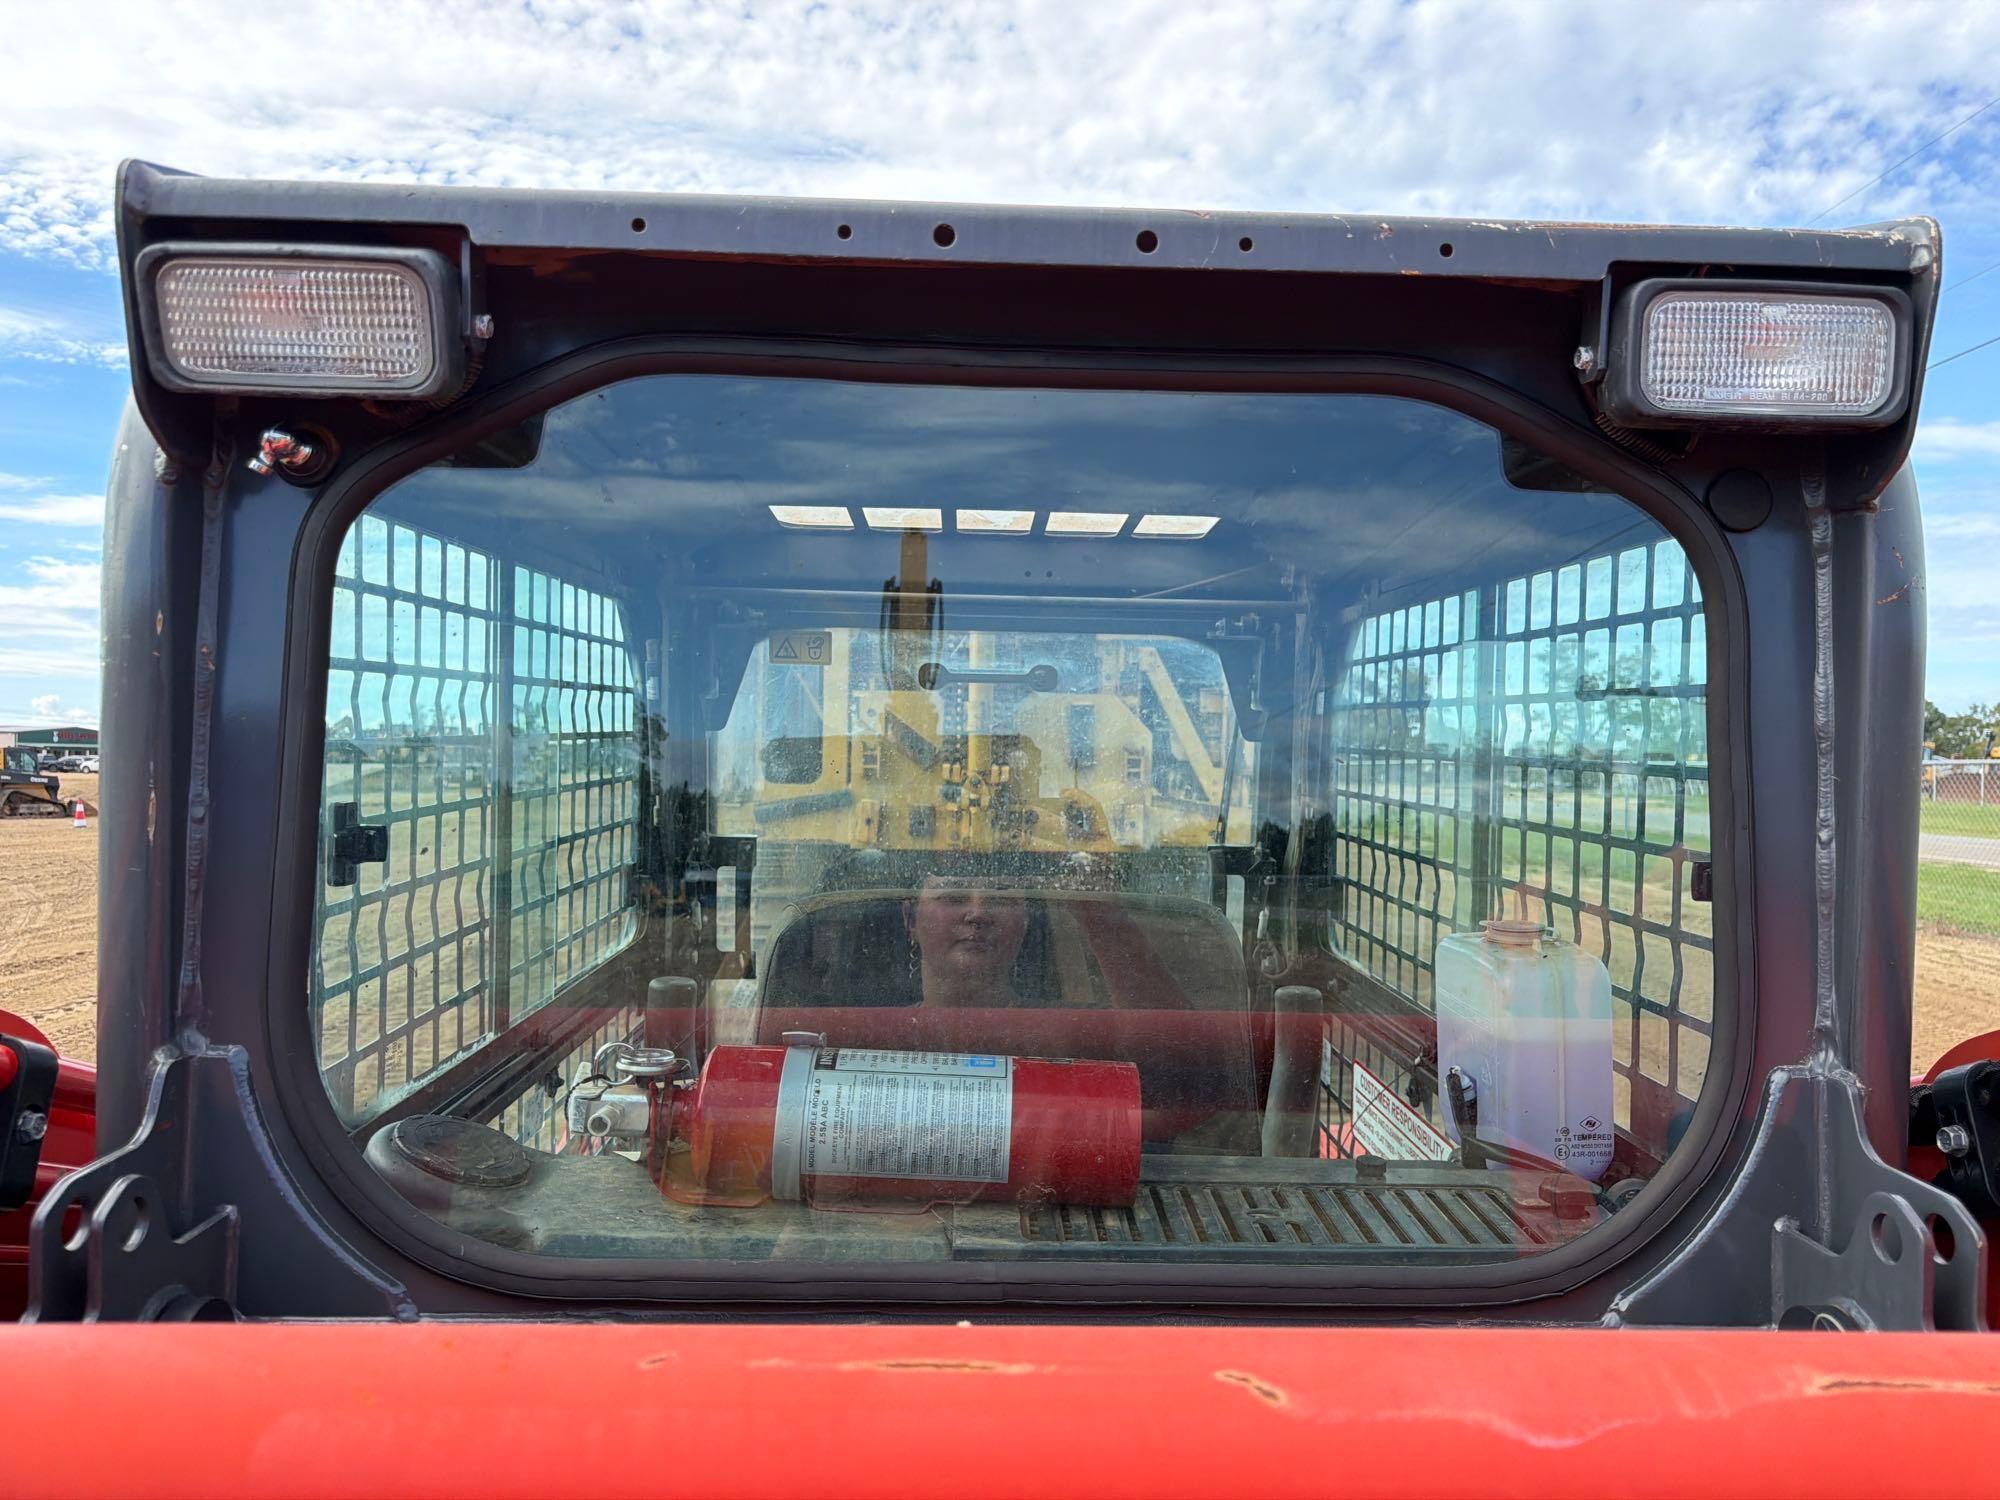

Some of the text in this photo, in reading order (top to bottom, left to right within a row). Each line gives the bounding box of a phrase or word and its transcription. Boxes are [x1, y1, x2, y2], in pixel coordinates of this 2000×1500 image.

[1750, 391, 1776, 400] BEAM
[819, 1049, 834, 1065] INS
[820, 1099, 829, 1119] ABC
[1391, 1101, 1445, 1161] RESPONSIBILITY
[1573, 1133, 1611, 1141] TEMPERED
[808, 1144, 816, 1168] MODEL
